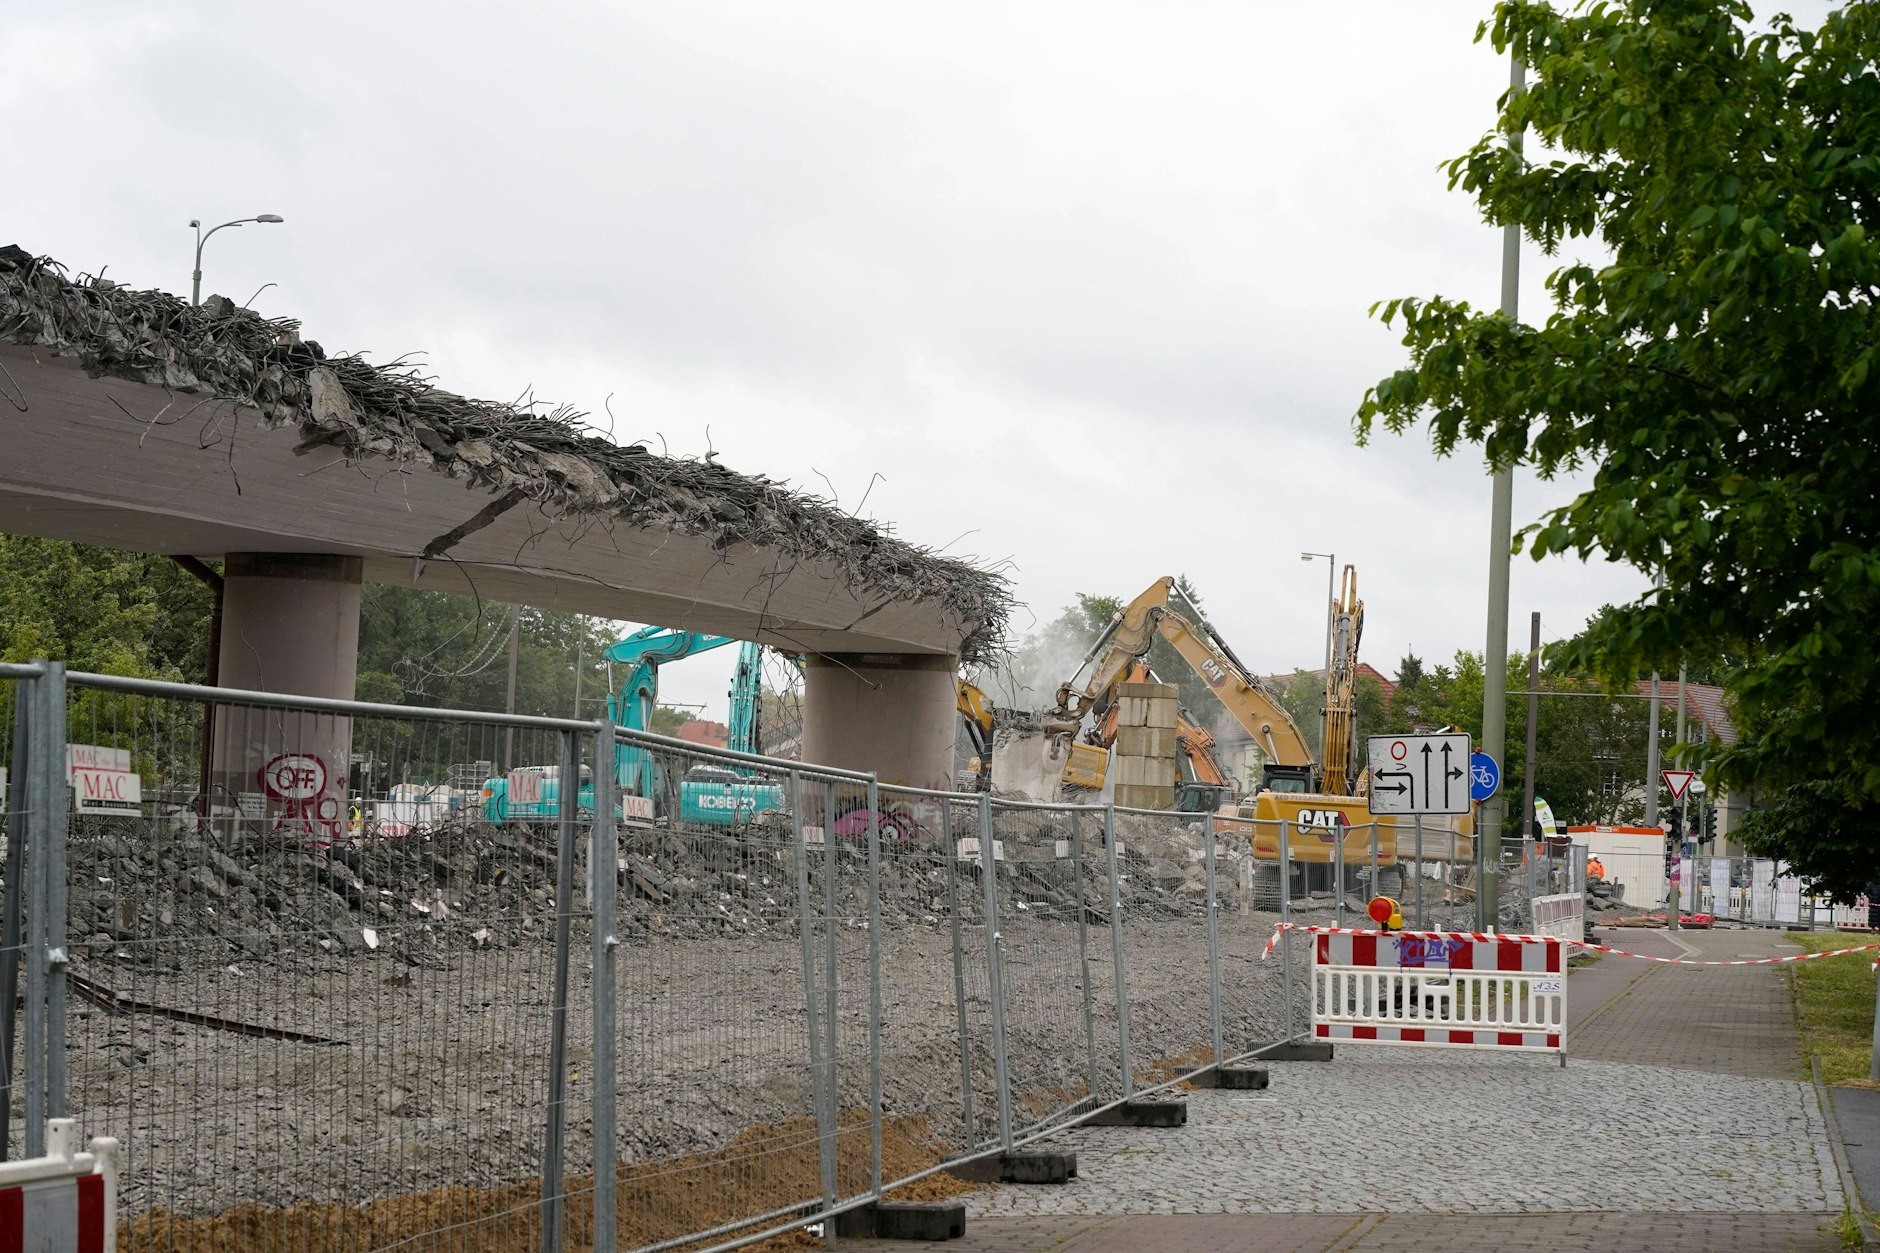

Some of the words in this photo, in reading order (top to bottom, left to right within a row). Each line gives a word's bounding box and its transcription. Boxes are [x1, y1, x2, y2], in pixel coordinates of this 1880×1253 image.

[1201, 658, 1226, 681] CAT
[76, 748, 100, 765] MAC
[83, 773, 127, 800] MAC
[508, 774, 541, 802] MAC
[626, 798, 649, 817] MAC
[698, 795, 756, 810] KOBELCO
[1297, 809, 1339, 836] CAT
